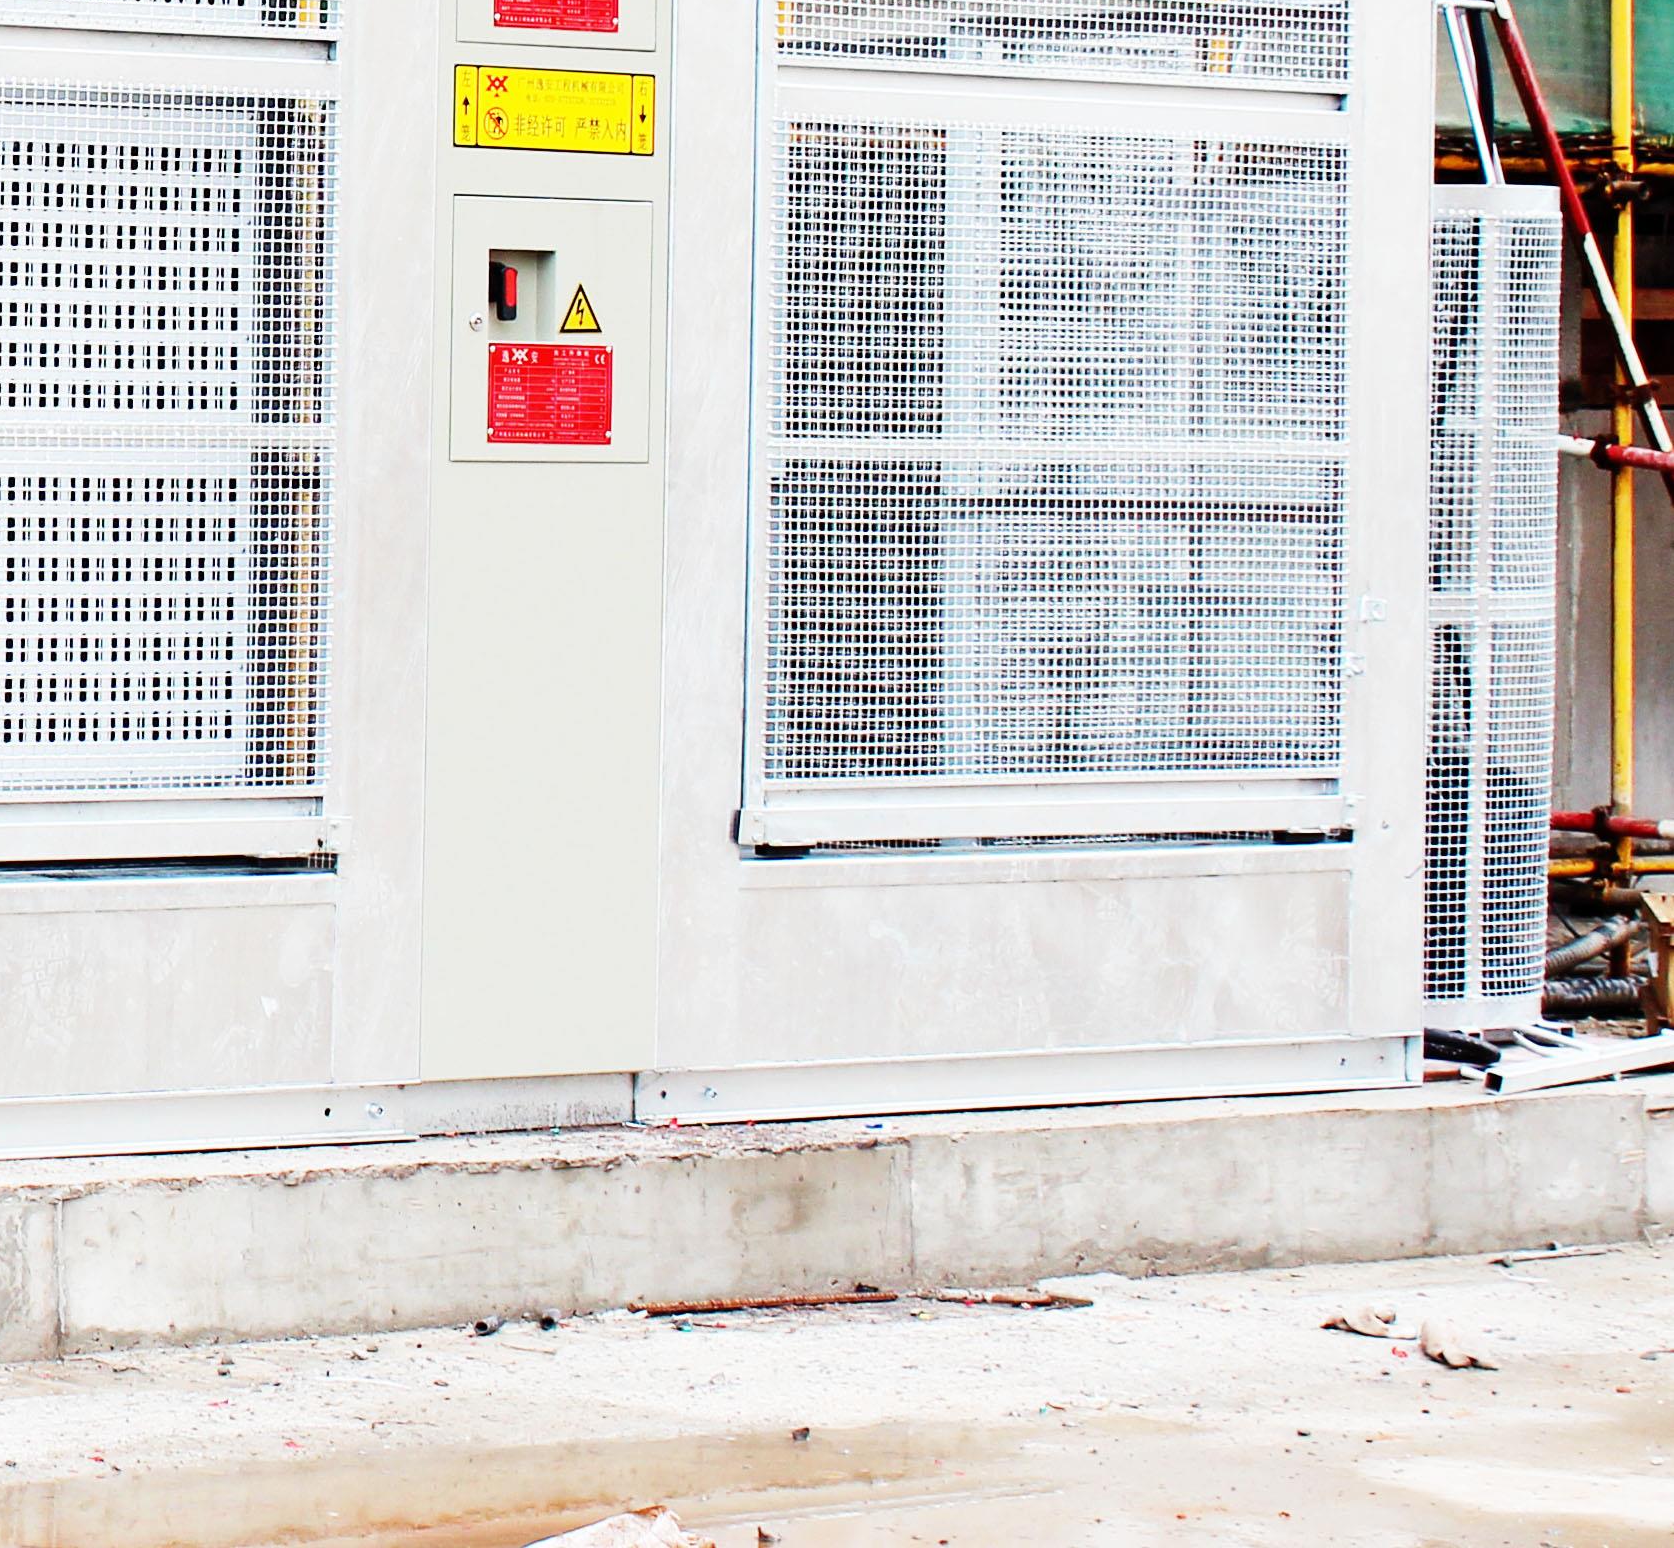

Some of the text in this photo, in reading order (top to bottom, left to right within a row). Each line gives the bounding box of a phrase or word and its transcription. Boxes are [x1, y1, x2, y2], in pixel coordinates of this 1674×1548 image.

[514, 114, 628, 143] 非经许可 严禁入内
